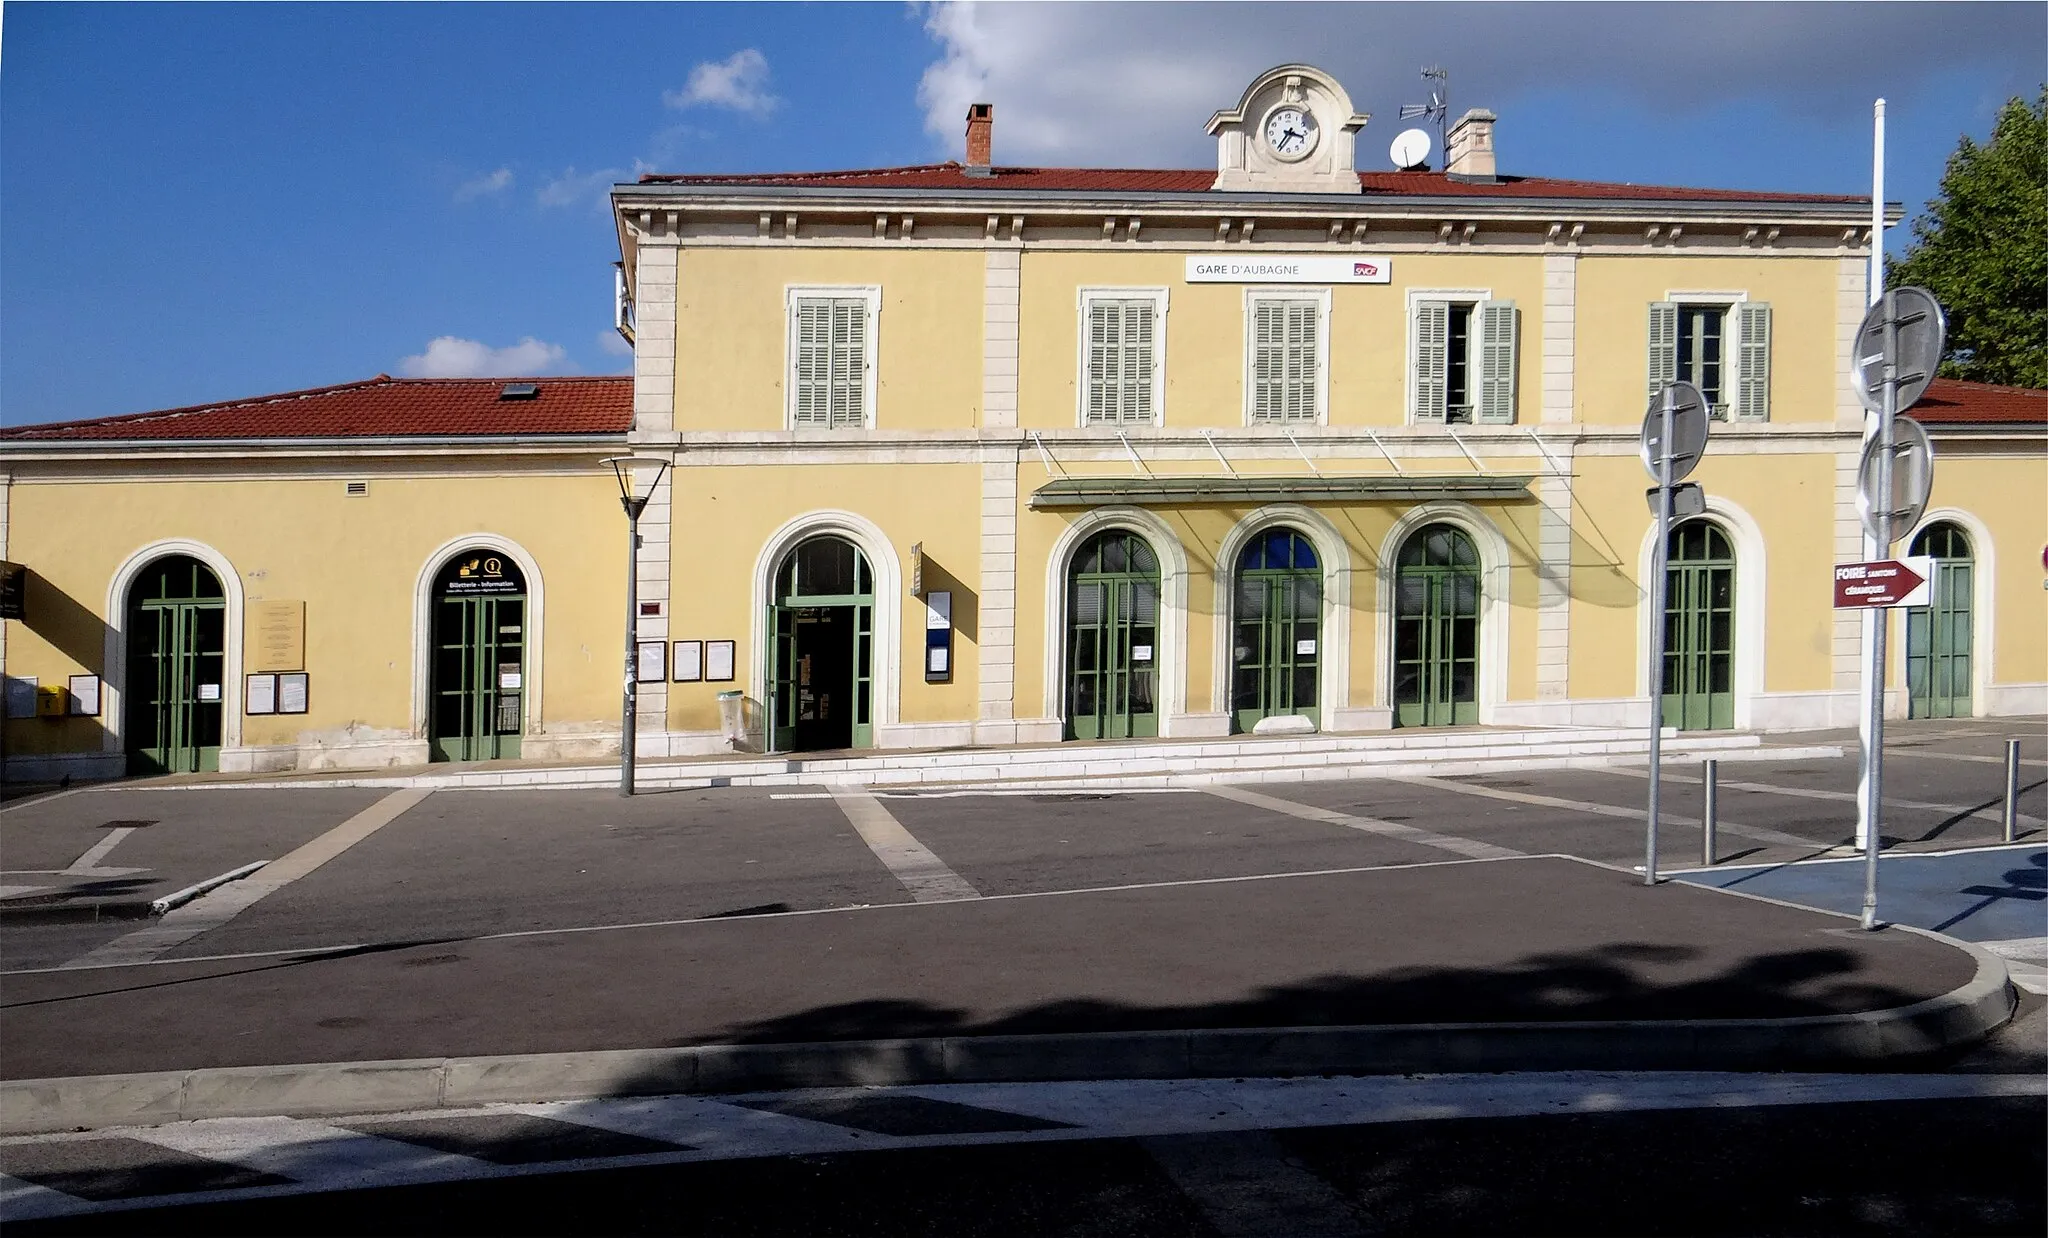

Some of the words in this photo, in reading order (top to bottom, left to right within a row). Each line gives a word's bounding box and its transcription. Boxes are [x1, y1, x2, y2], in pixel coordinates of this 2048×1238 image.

[1196, 264, 1228, 274] GARE
[1231, 265, 1299, 275] D'AUBAGNE
[1355, 266, 1377, 275] SNCF
[1836, 566, 1866, 580] FOIRE
[1867, 569, 1897, 578] SANTONS
